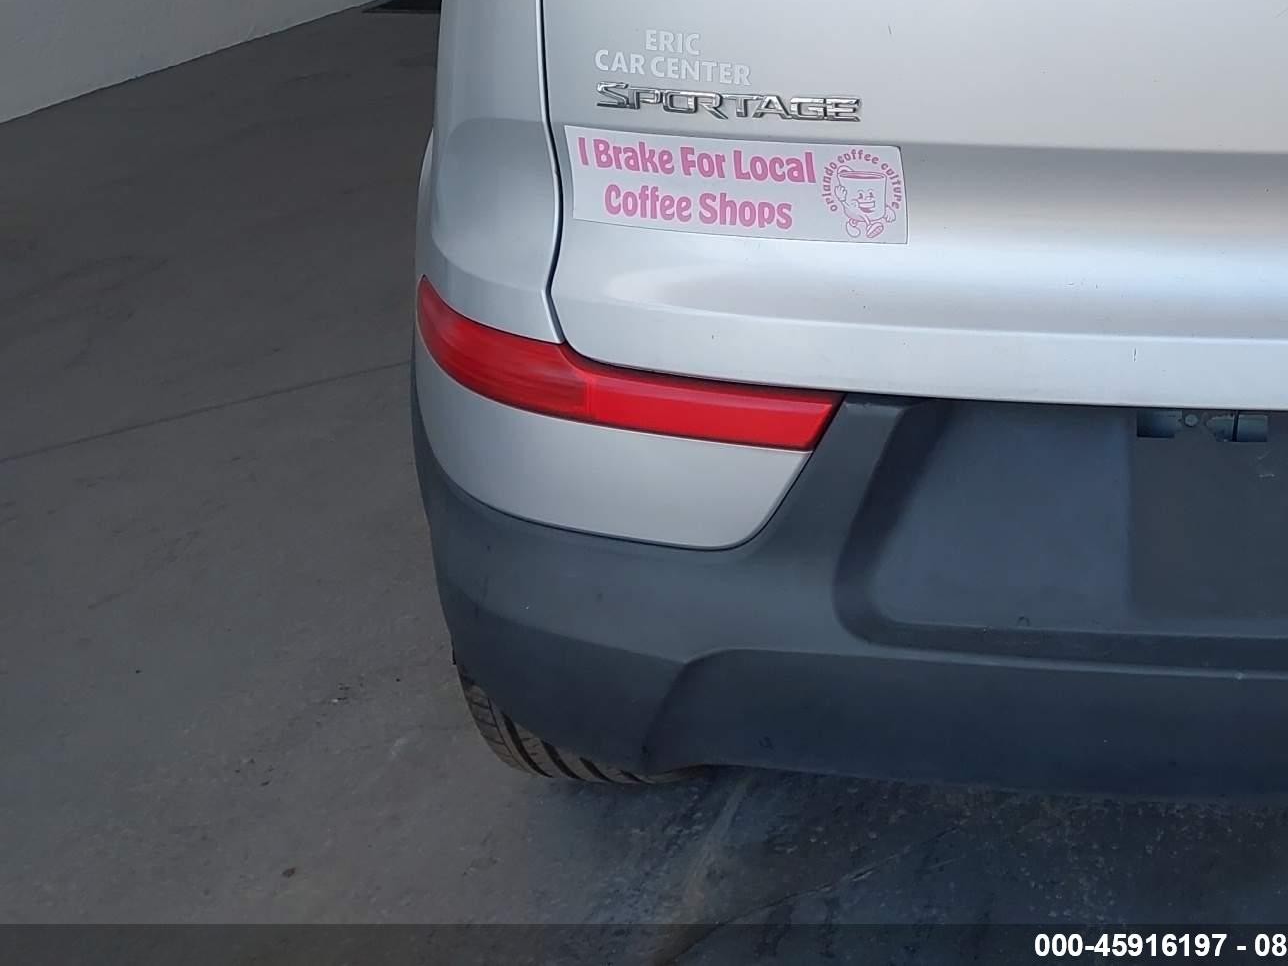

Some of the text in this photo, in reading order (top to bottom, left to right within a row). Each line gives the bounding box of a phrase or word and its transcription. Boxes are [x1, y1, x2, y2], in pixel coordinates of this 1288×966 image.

[645, 29, 701, 56] ERIC
[594, 49, 752, 86] CAR CENTER
[596, 81, 862, 122] SPORTAGE
[577, 136, 817, 184] I Brake For Local
[837, 149, 880, 165] coffee
[881, 162, 903, 210] culture
[604, 183, 793, 230] Coffee Shops
